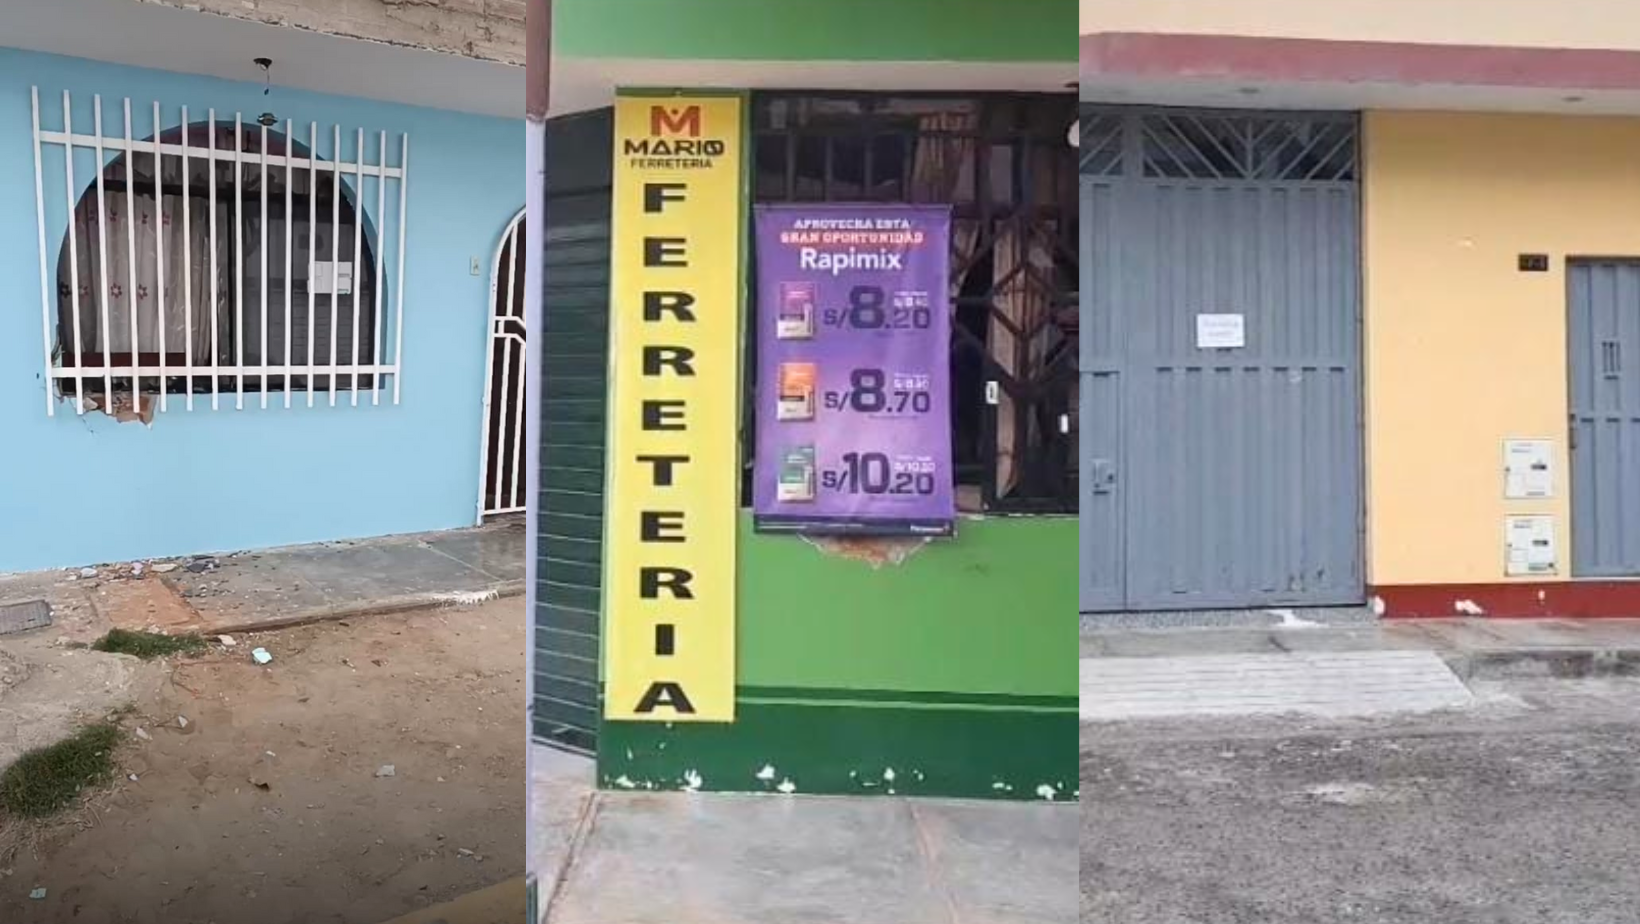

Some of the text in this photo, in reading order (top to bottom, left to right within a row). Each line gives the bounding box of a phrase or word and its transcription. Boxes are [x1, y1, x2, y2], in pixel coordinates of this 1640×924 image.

[624, 139, 724, 156] MARIO
[630, 158, 713, 169] FERRETERIA
[794, 218, 911, 229] APROVECHA ESTA
[780, 231, 924, 243] GRAN OPORTUNIDAD
[800, 246, 902, 276] Rapimix
[634, 183, 697, 714] FERRETERIA
